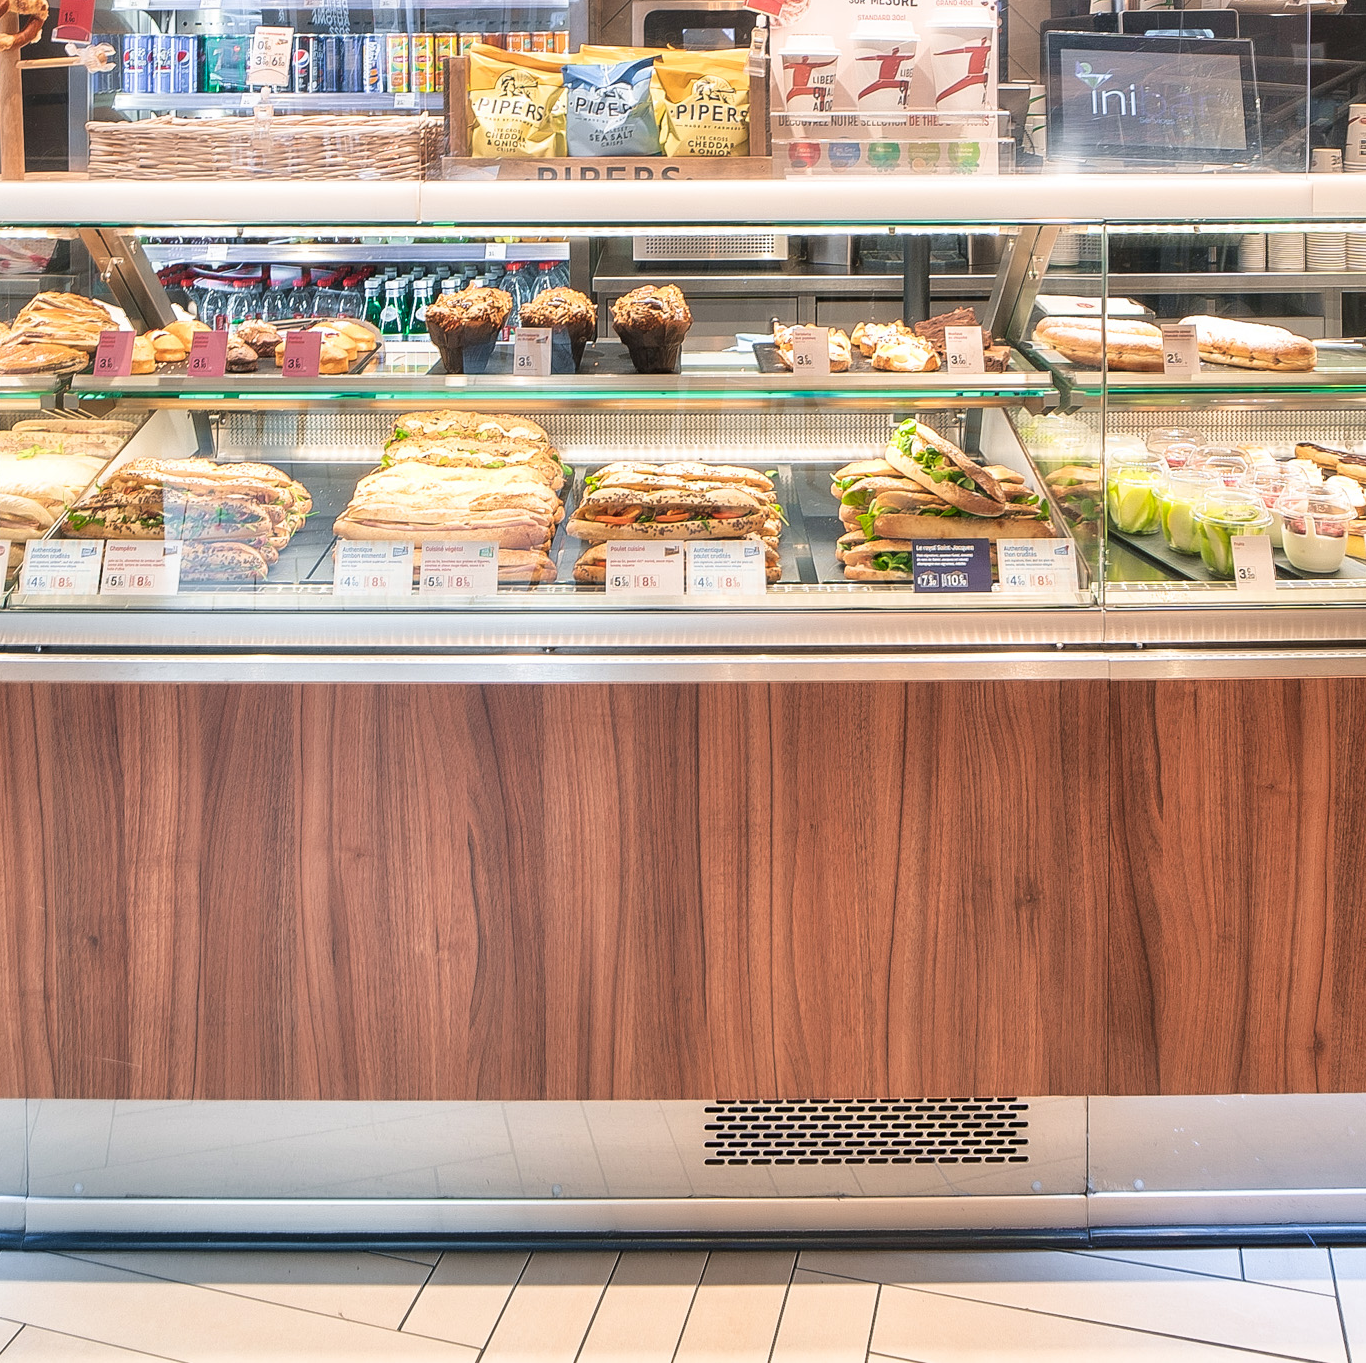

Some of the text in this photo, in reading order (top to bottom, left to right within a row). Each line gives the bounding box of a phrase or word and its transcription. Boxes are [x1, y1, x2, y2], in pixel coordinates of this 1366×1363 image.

[477, 98, 545, 122] PIPERS
[590, 130, 634, 142] SEA SALT
